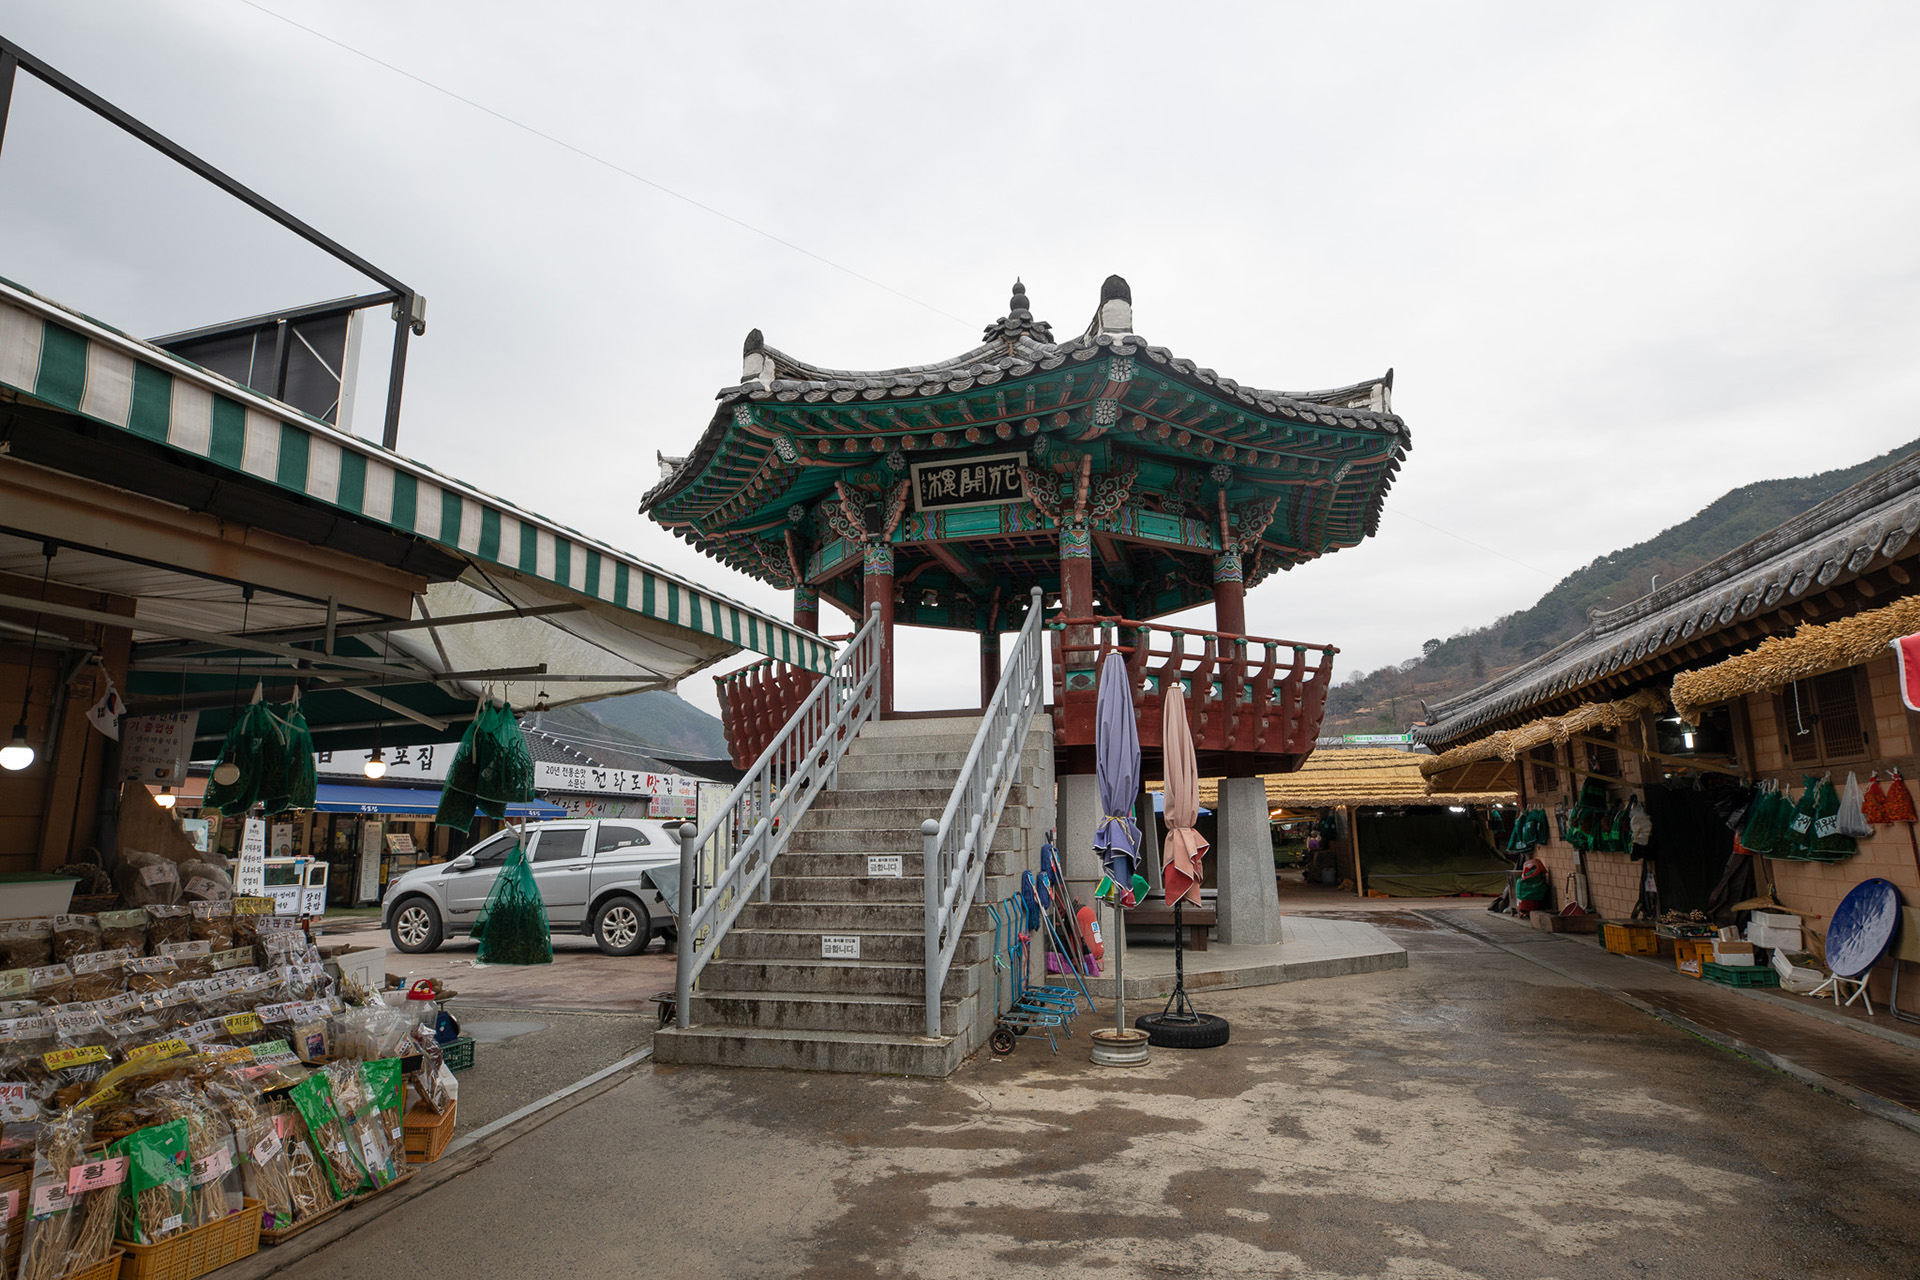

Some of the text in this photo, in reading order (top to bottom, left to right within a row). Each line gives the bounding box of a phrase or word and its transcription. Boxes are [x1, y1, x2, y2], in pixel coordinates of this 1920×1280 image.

[144, 723, 174, 735] 졸업생
[546, 765, 587, 778] 20년 전통손맛
[567, 779, 586, 789] 소문난
[305, 892, 321, 902] 장터
[304, 902, 321, 911] 국밥
[260, 919, 292, 928] 야관문
[131, 1040, 183, 1058] 상황버섯
[47, 1046, 103, 1064] 상황버섯
